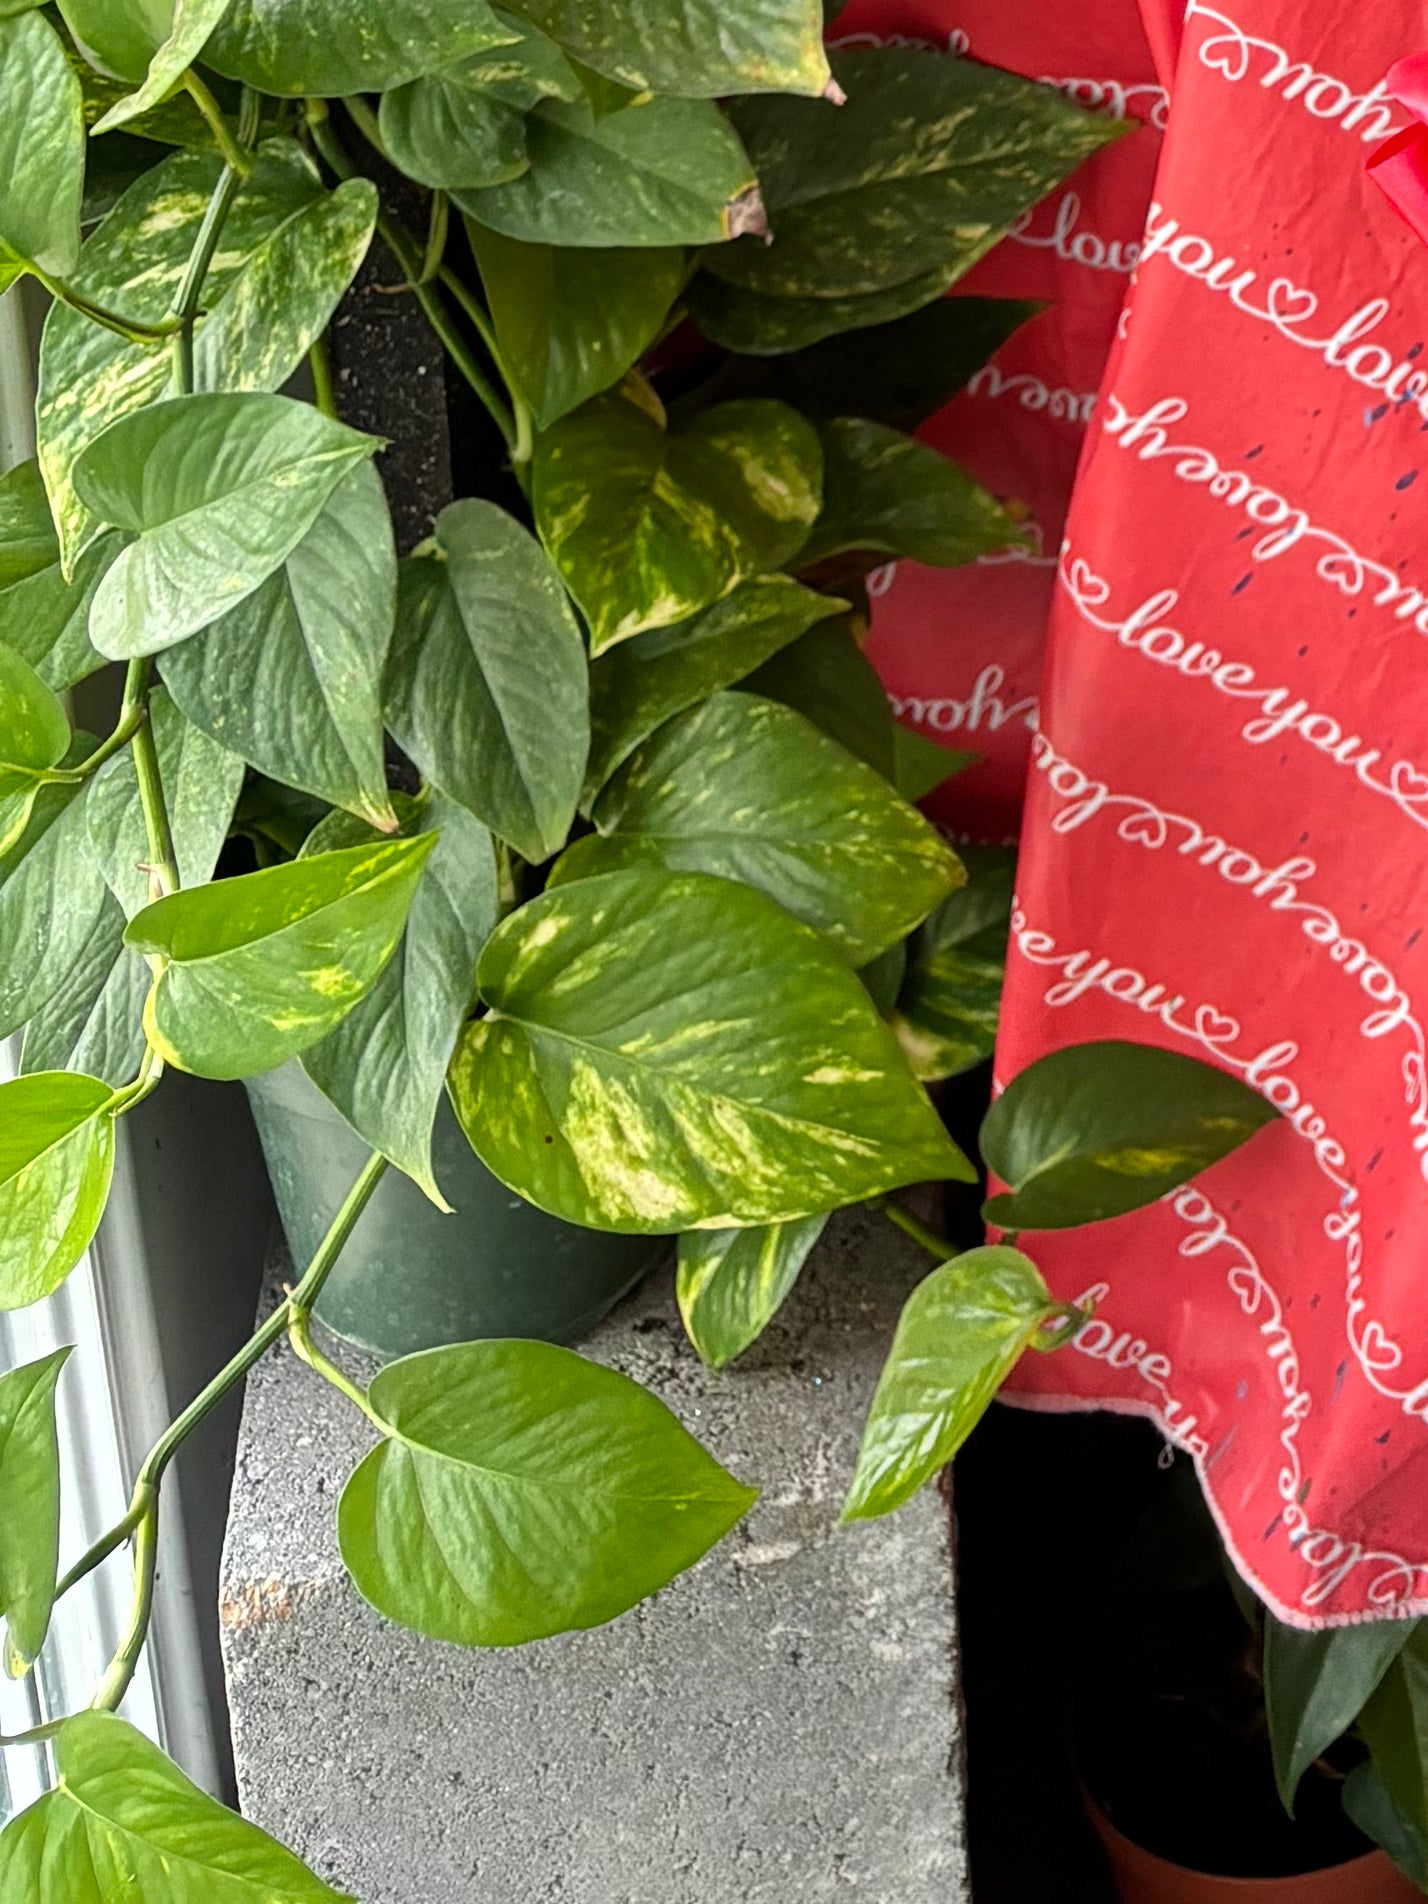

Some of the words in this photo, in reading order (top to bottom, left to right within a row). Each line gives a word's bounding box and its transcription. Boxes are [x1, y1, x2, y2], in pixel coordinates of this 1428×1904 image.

[1055, 193, 1143, 273] lov
[1175, 446, 1309, 562] love
[1119, 589, 1256, 696] love
[1242, 688, 1381, 772] you
[1179, 821, 1316, 909] you
[1301, 906, 1411, 1038] love
[1044, 950, 1184, 1022] you
[1244, 1041, 1347, 1177] love
[1323, 1188, 1366, 1317] you
[1260, 1310, 1312, 1450] you
[1279, 1463, 1362, 1606] love
